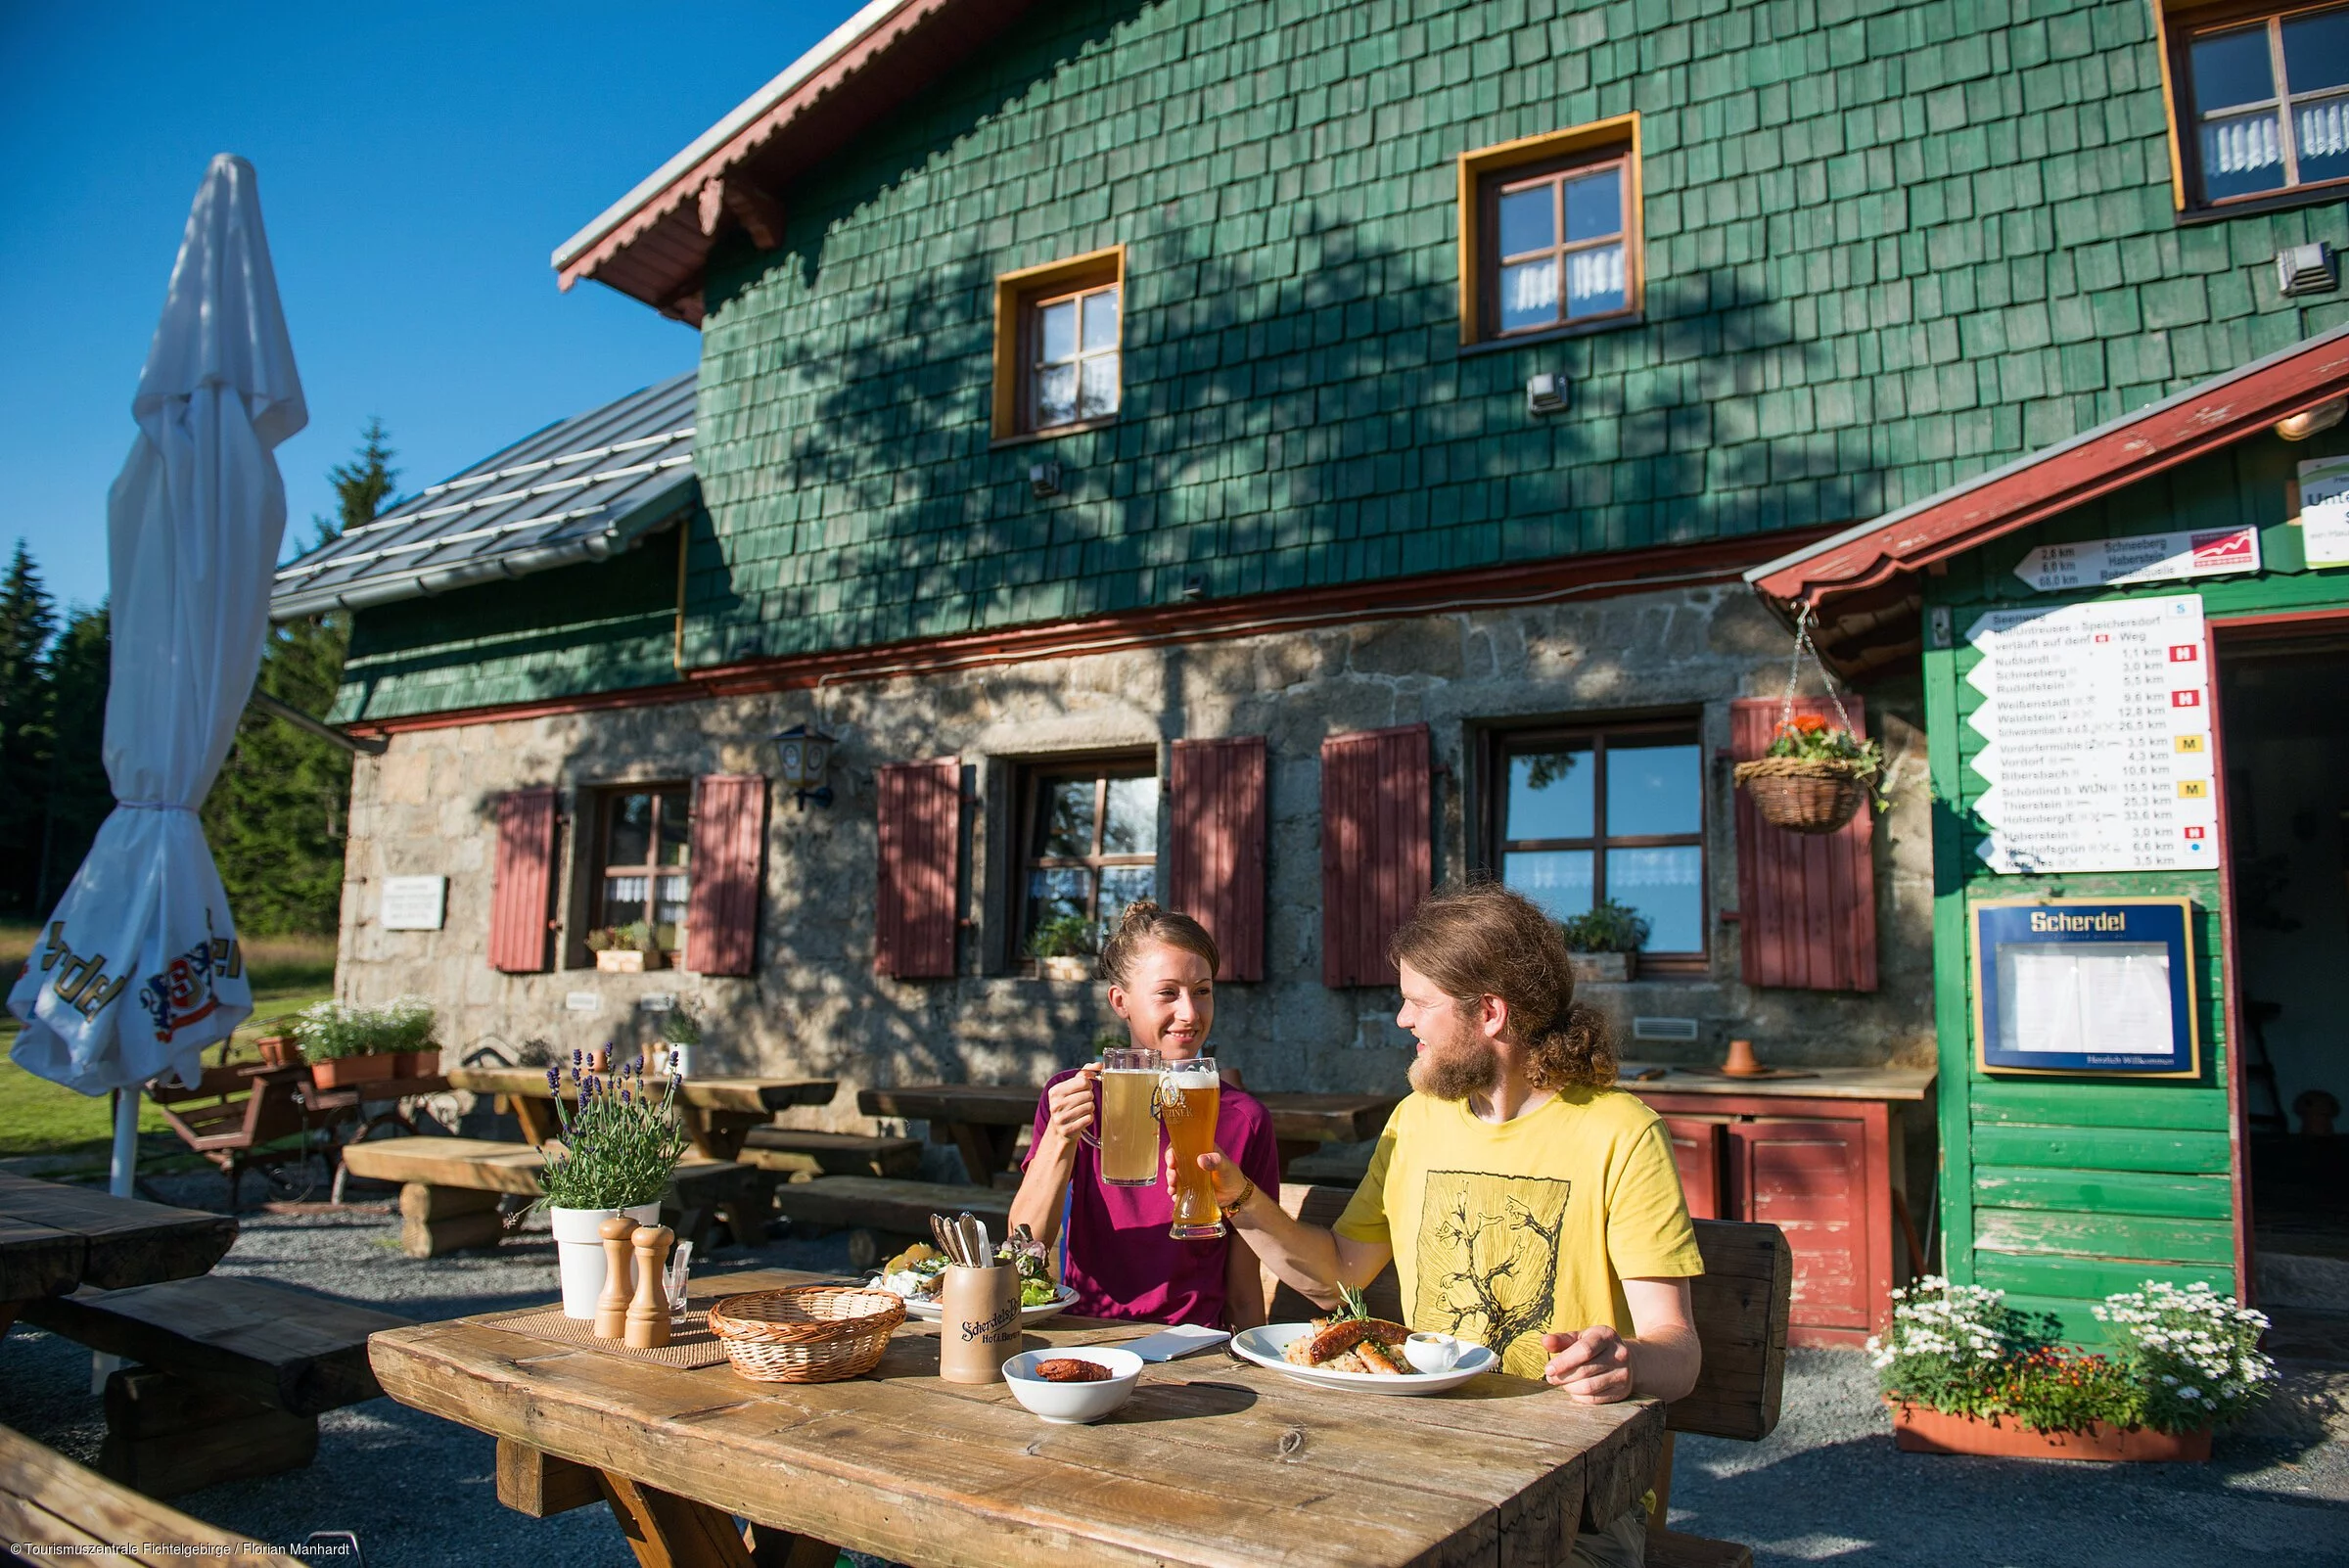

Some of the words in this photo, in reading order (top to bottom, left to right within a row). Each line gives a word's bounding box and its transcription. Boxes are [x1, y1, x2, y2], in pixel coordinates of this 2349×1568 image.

[2059, 548, 2075, 558] km
[2104, 537, 2167, 553] Schneeberg
[2060, 561, 2076, 572] km
[2107, 552, 2165, 566] Haberstein
[2062, 574, 2079, 584] km
[2177, 603, 2186, 615] S
[2082, 616, 2161, 632] Speichersdorf
[2043, 637, 2061, 648] auf
[2120, 632, 2146, 642] Weg
[2123, 649, 2139, 659] 1,1
[2176, 647, 2189, 660] H
[1997, 669, 2066, 680] Schneeberg
[2144, 661, 2163, 669] km
[1997, 682, 2064, 693] Rudolfstein
[1998, 698, 2070, 710] Weißenstadt
[2146, 692, 2165, 701] km
[2179, 692, 2192, 705] H
[1998, 714, 2055, 723] Waldstein
[2147, 706, 2165, 715] km
[1999, 725, 2064, 737] Schwarzenbach
[2148, 720, 2166, 729] km
[2149, 737, 2168, 746] km
[2183, 739, 2196, 749] M
[2001, 756, 2044, 766] Vordorf
[2150, 751, 2169, 760] km
[2002, 769, 2069, 781] Bibersbach
[2151, 764, 2170, 773] km
[2002, 786, 2060, 798] Schönlind
[2152, 782, 2171, 791] km
[2186, 784, 2199, 795] M
[2004, 799, 2062, 810] Thierstein
[2153, 796, 2172, 805] km
[2154, 810, 2173, 819] km
[2155, 826, 2173, 836] km
[2157, 855, 2175, 864] km
[2030, 911, 2126, 933] Scherdel
